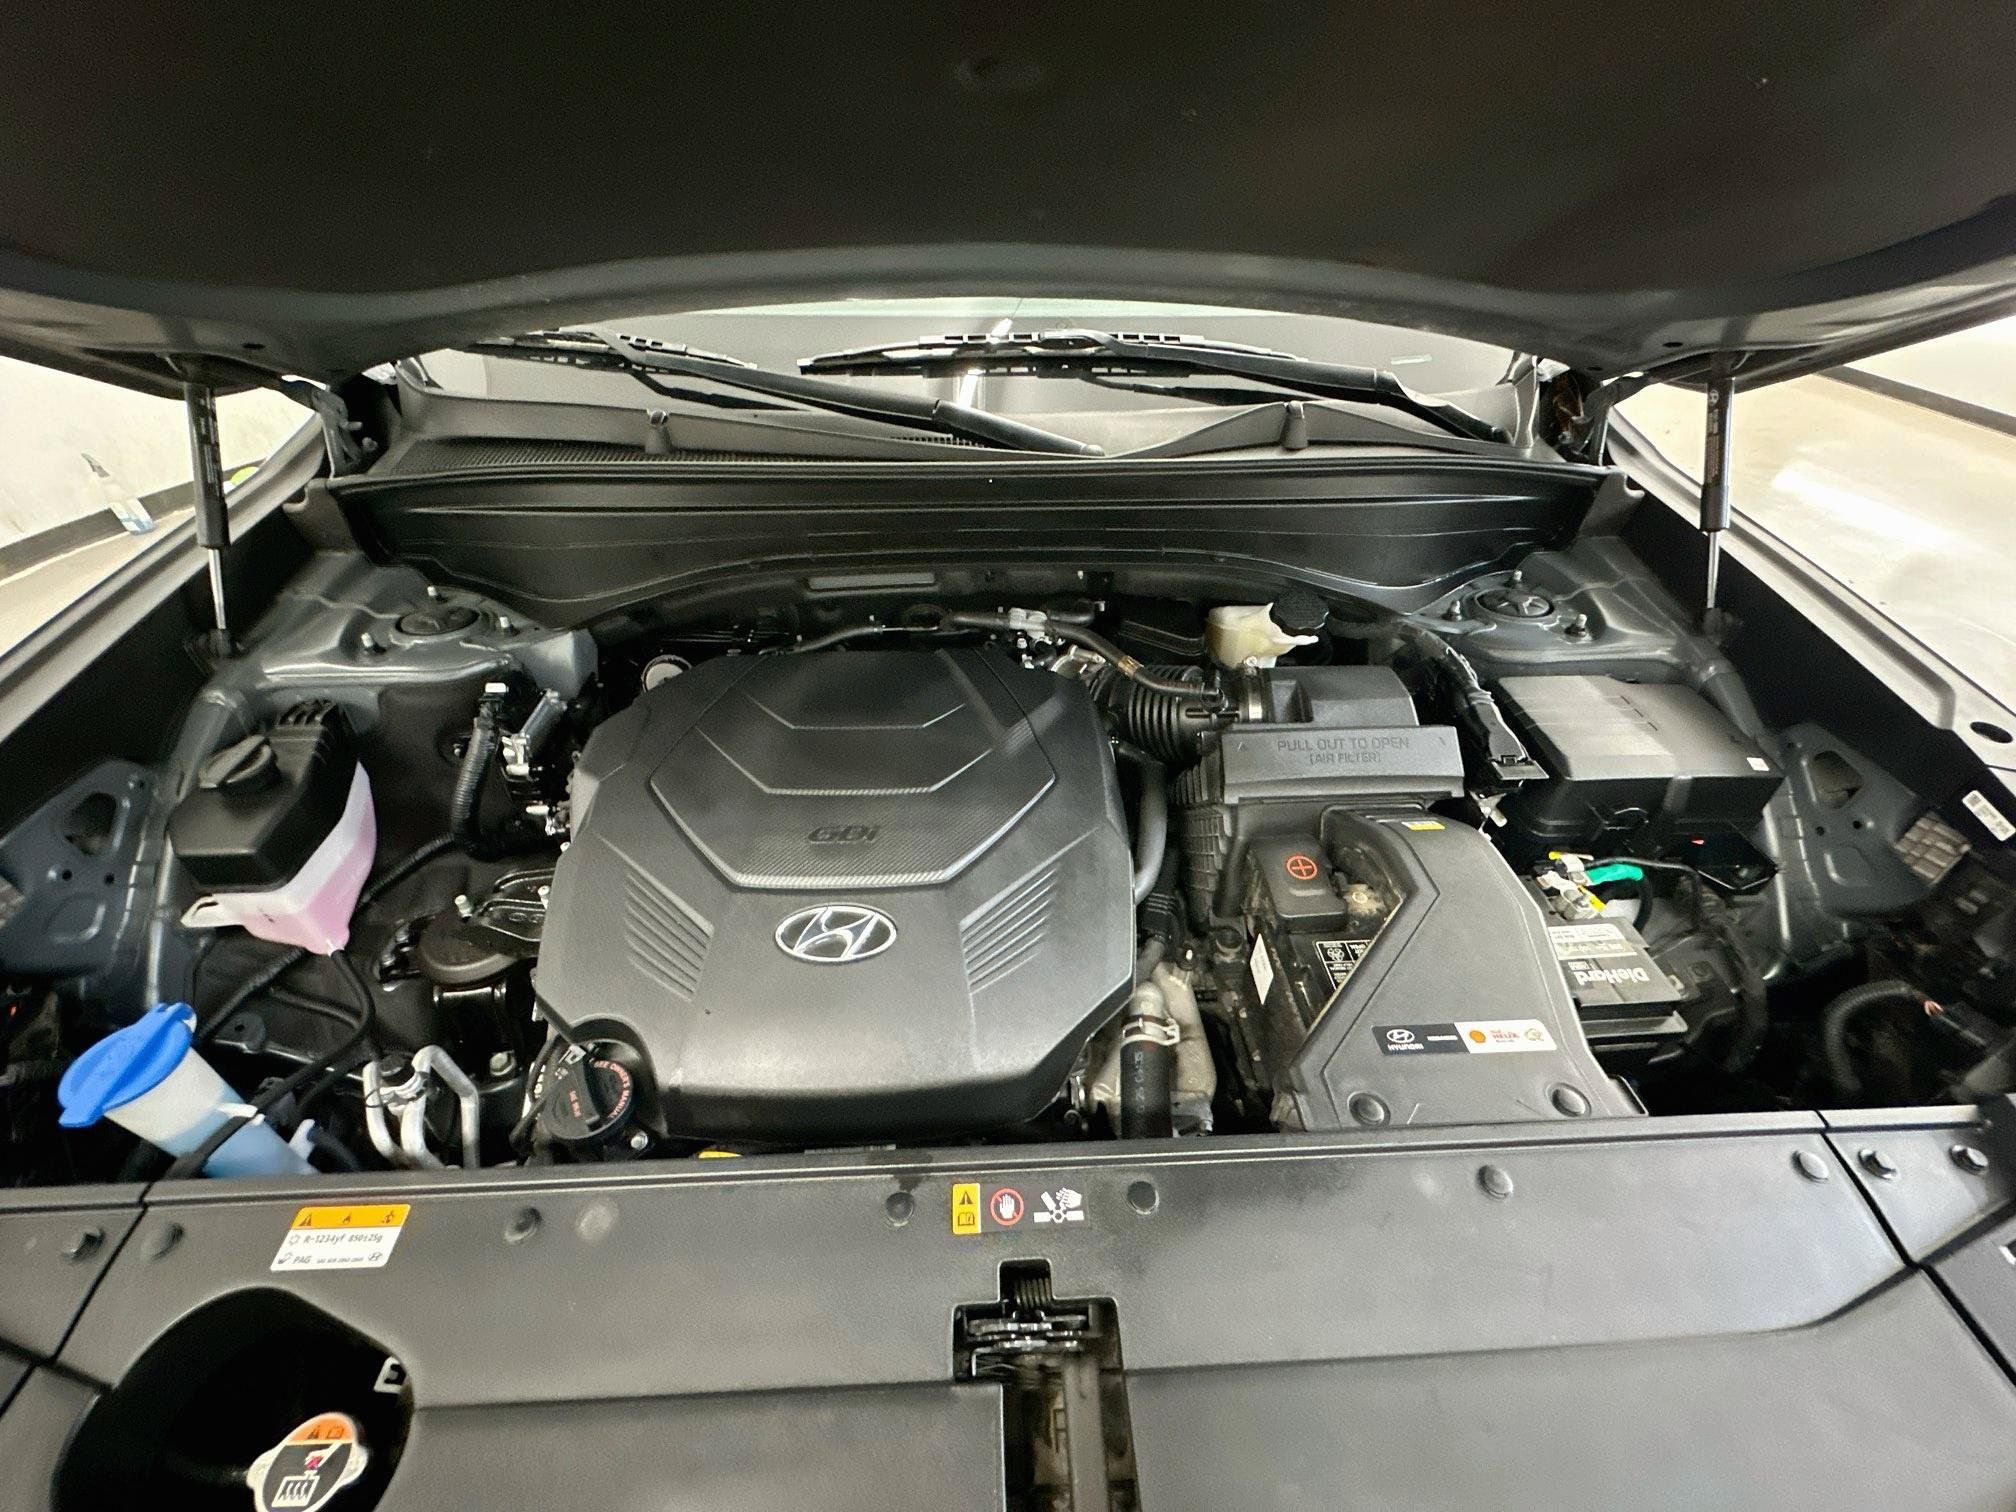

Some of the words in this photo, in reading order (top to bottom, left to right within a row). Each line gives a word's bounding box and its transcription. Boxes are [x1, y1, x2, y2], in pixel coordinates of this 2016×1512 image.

[1277, 740, 1313, 752] PULL
[1316, 738, 1346, 751] OUT
[1350, 737, 1368, 749] TO
[1371, 736, 1410, 749] OPEN
[1573, 967, 1651, 986] DieHard
[1387, 1042, 1425, 1051] HYUNDAI
[304, 1233, 346, 1246] R-1234yf
[292, 1255, 313, 1265] PAG
